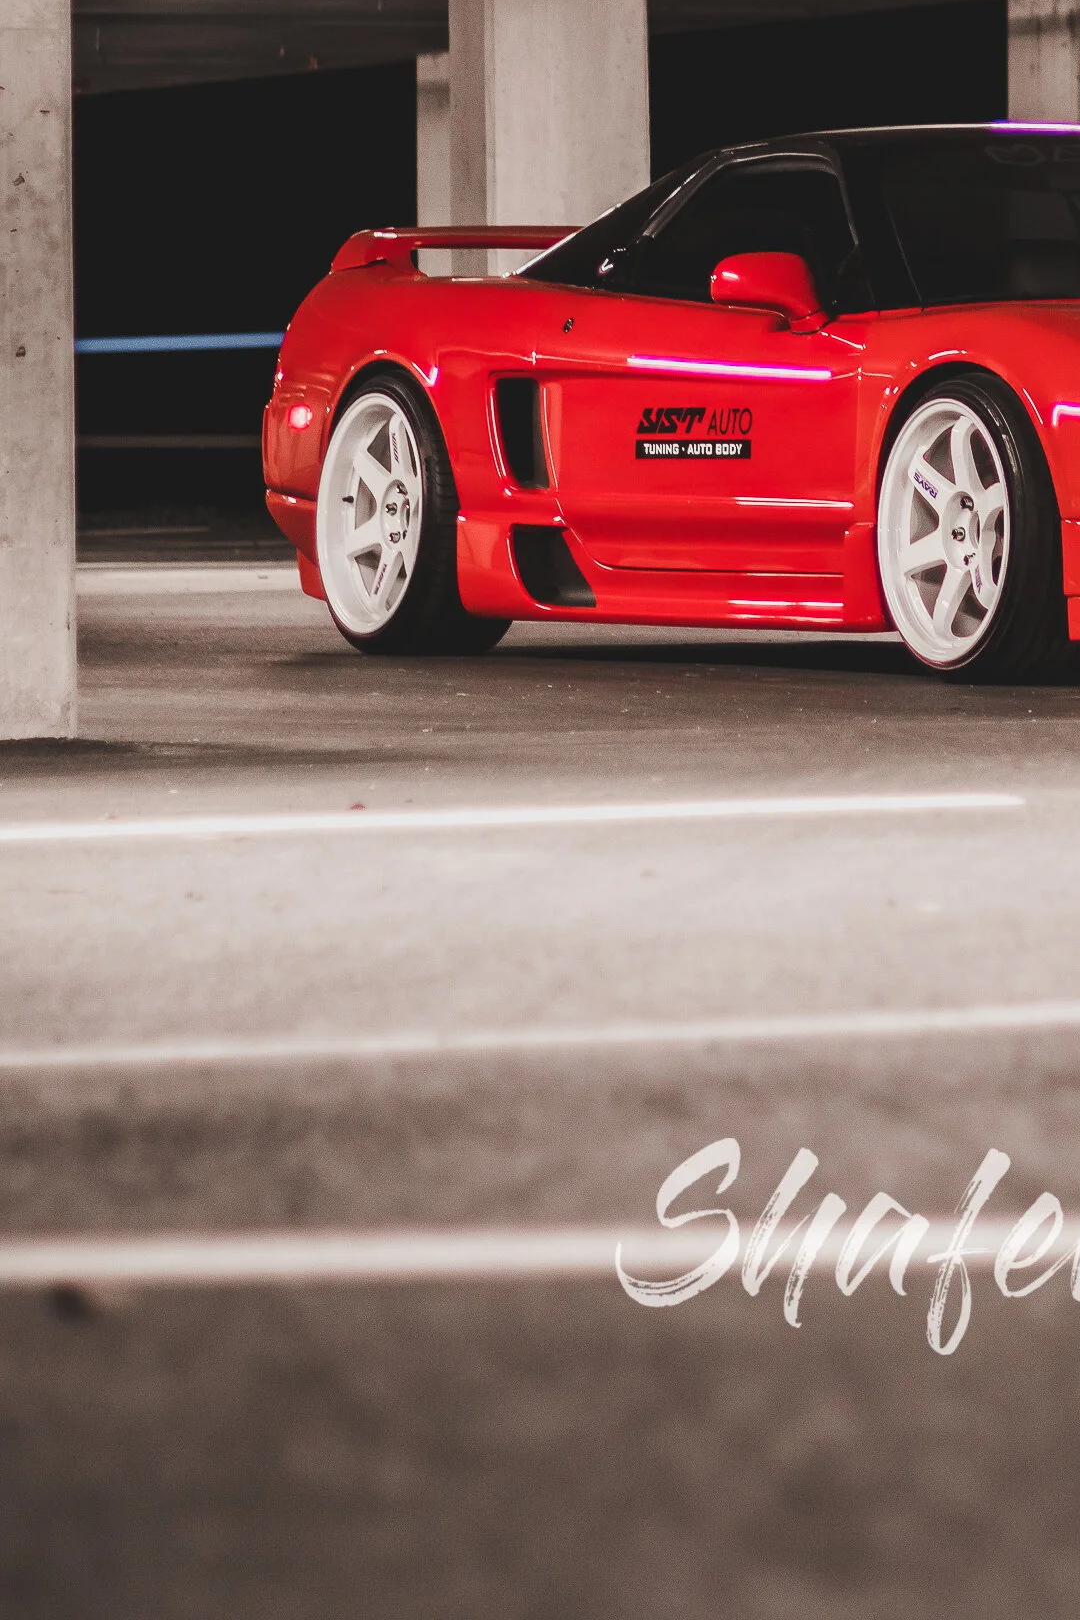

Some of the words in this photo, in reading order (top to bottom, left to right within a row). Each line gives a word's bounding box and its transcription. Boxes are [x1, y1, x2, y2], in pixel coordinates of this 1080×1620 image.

[707, 408, 752, 435] AUTO
[644, 443, 679, 455] TUNING
[687, 443, 713, 455] AUTO
[715, 443, 743, 455] BODY
[913, 472, 938, 499] RAYS
